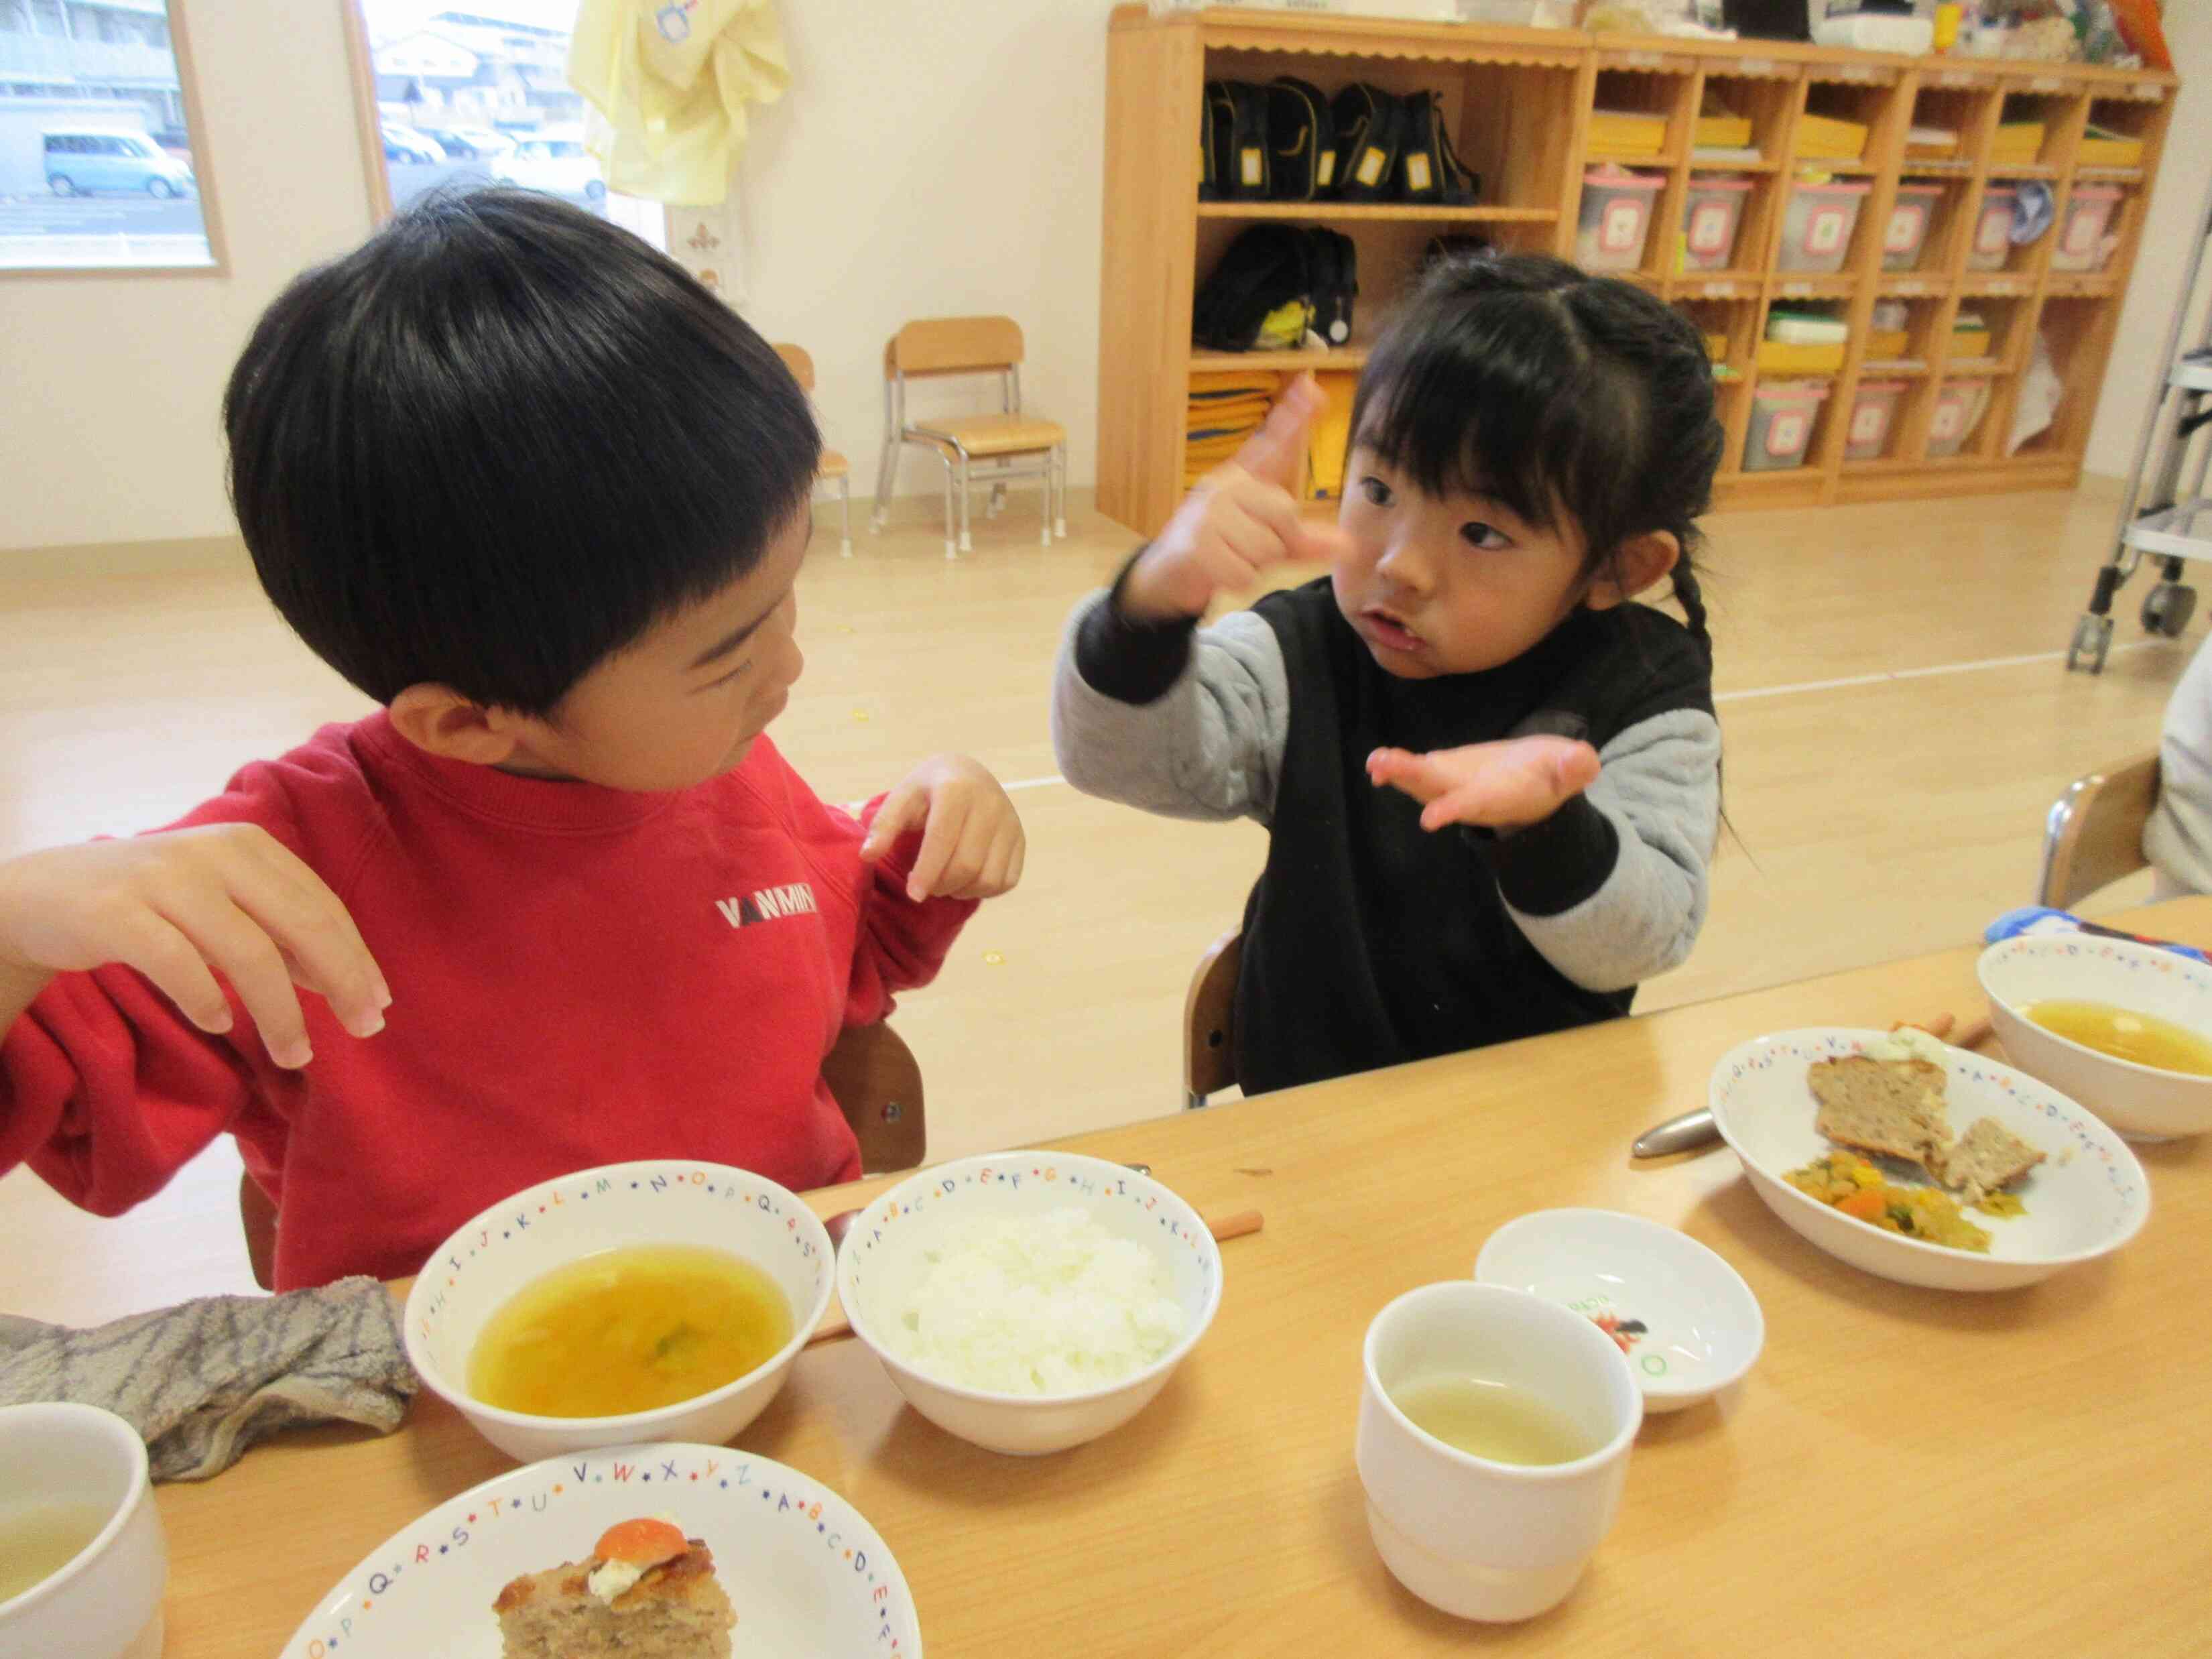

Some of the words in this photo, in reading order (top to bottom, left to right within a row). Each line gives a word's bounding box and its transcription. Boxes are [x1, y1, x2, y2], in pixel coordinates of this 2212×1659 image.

[516, 1213, 530, 1229] K
[596, 1178, 611, 1194] M
[650, 1175, 667, 1192] N
[691, 1171, 706, 1185] O
[758, 1194, 771, 1212] Q
[942, 1179, 955, 1193] D
[1117, 1180, 1125, 1194] I
[369, 1573, 393, 1594] Q
[415, 1544, 429, 1562] R
[452, 1526, 469, 1546] S
[487, 1497, 503, 1516] T
[532, 1493, 546, 1512] U
[573, 1462, 587, 1482] V
[613, 1462, 635, 1483] W
[661, 1459, 678, 1481] X
[706, 1459, 719, 1479] Y
[737, 1463, 751, 1485] Z
[778, 1493, 790, 1512] A
[809, 1501, 823, 1520] B
[855, 1551, 866, 1572] D
[874, 1585, 887, 1603] E
